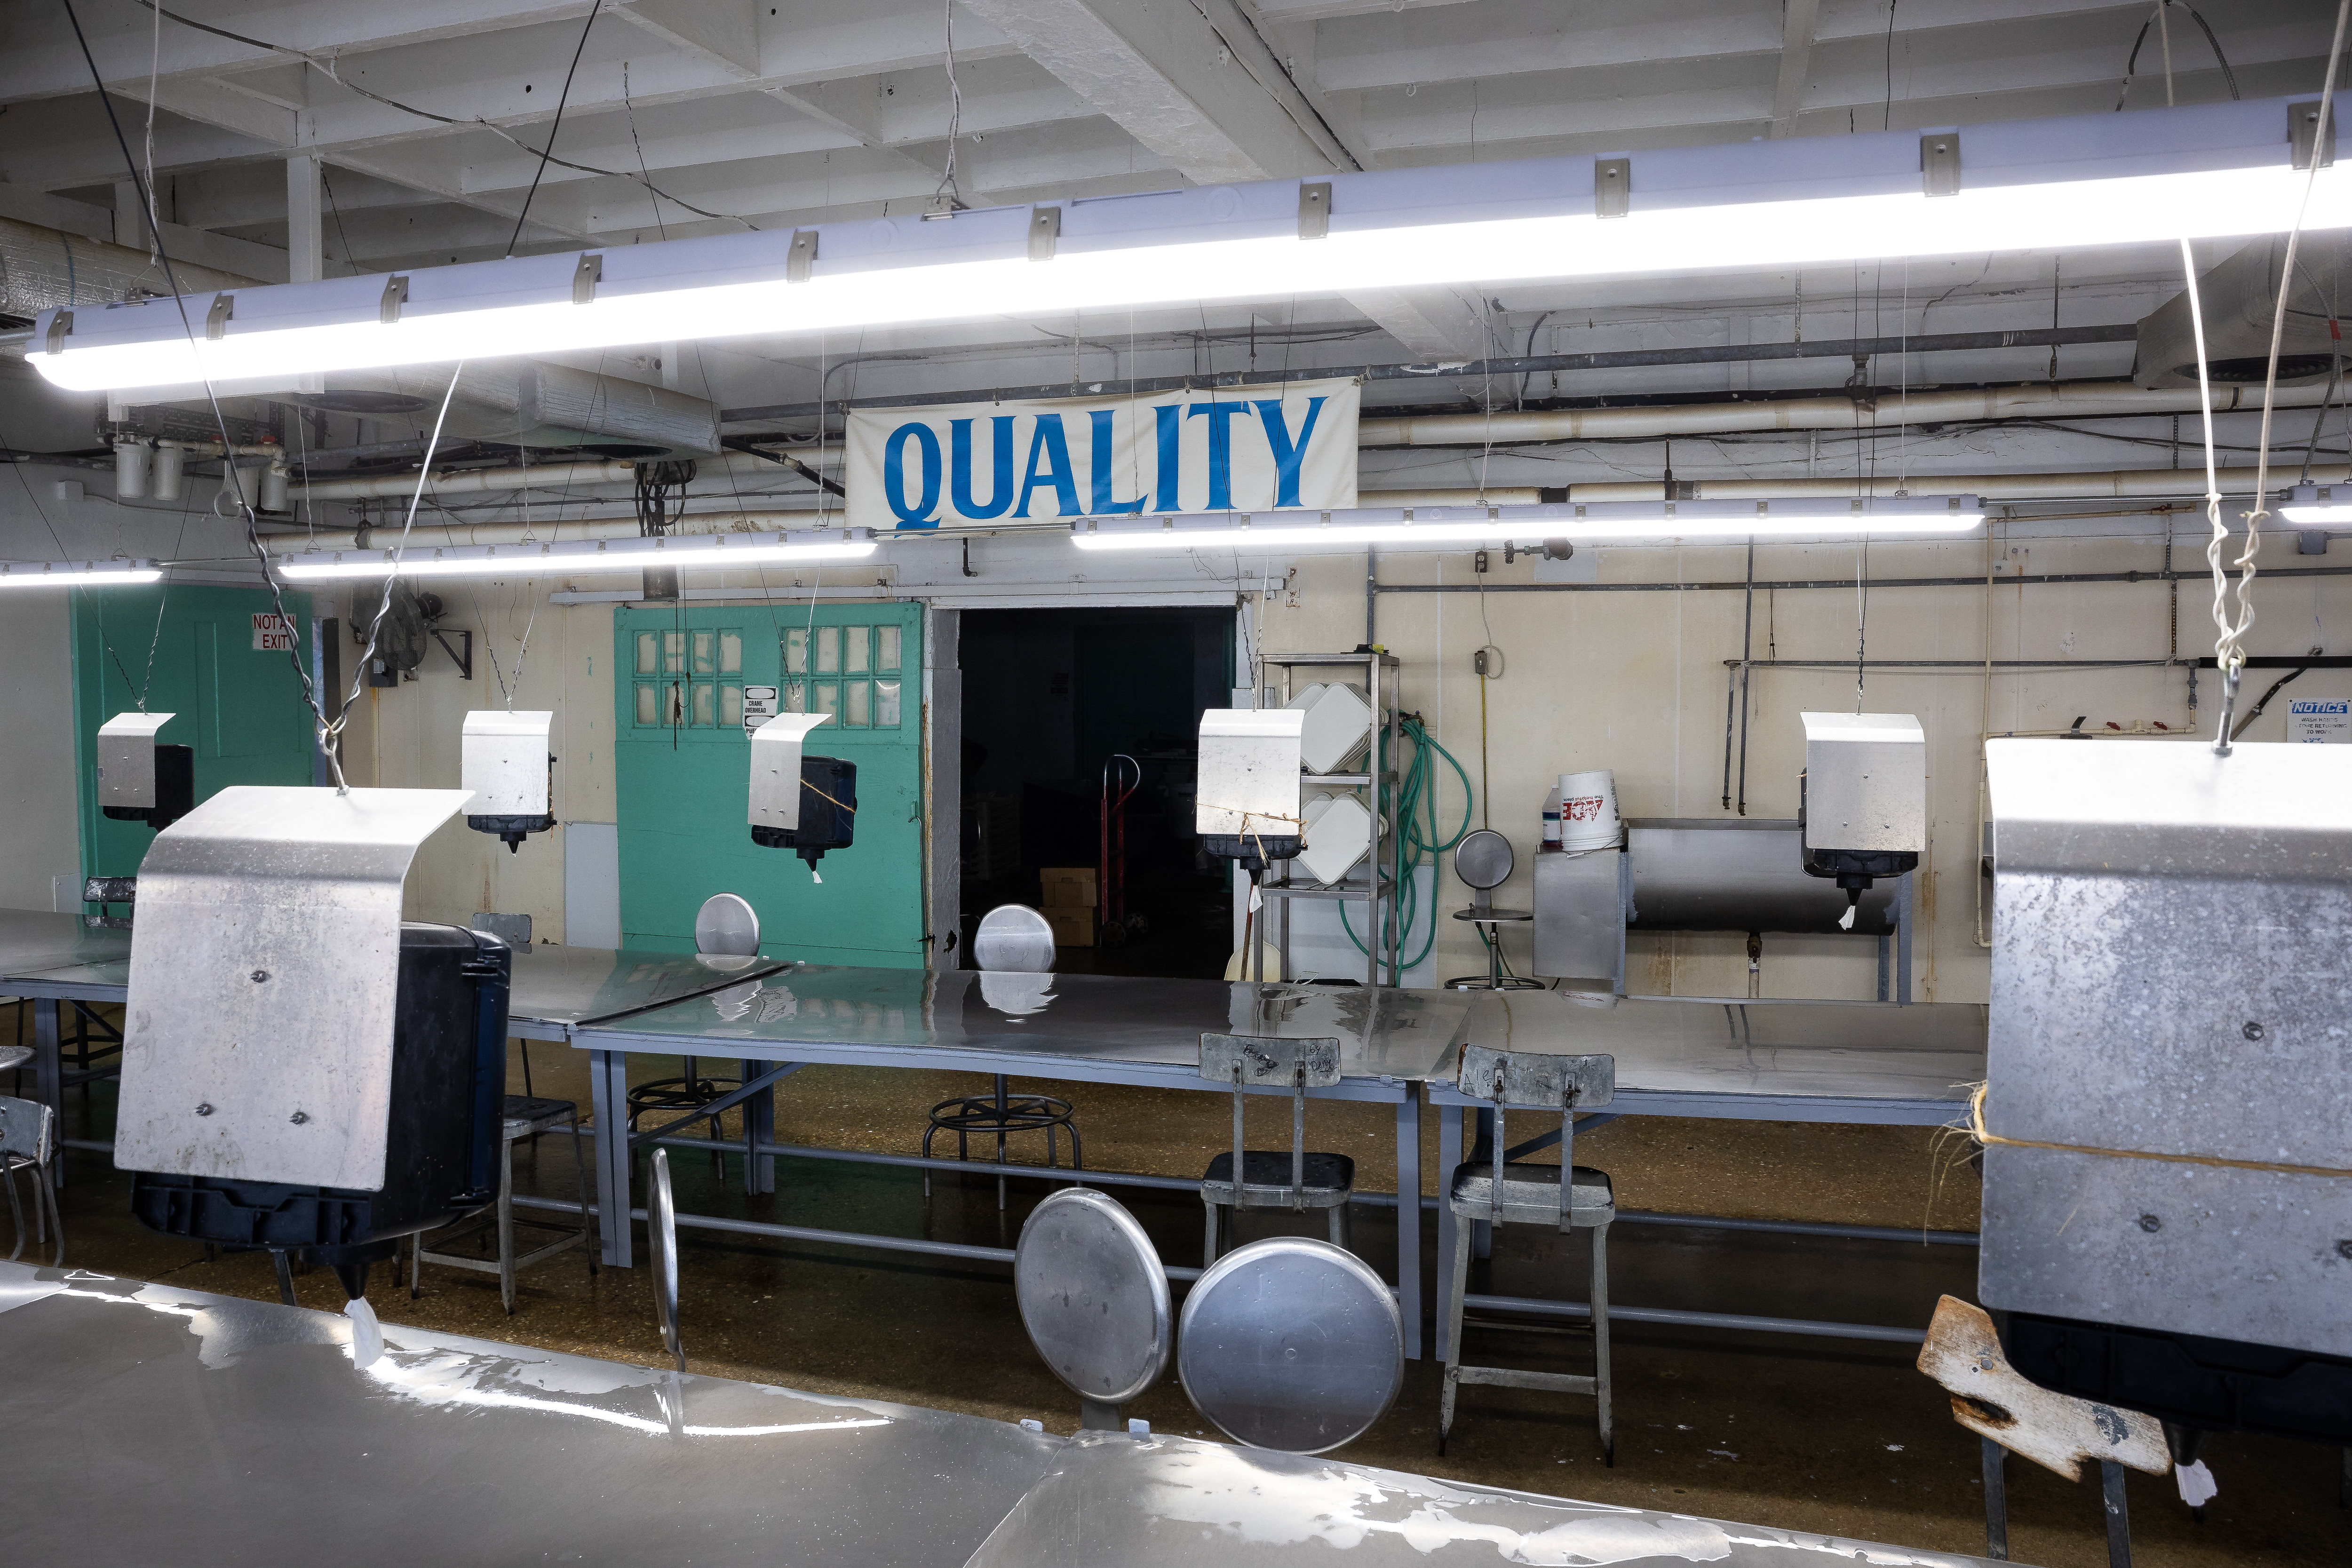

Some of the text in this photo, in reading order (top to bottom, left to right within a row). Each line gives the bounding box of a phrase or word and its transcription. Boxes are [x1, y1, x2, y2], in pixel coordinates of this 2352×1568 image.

[884, 396, 1329, 538] QUALITY
[253, 614, 278, 630] NOT
[262, 634, 288, 649] EXIT
[2294, 702, 2346, 713] NOTICE
[1563, 799, 1604, 821] ACE
